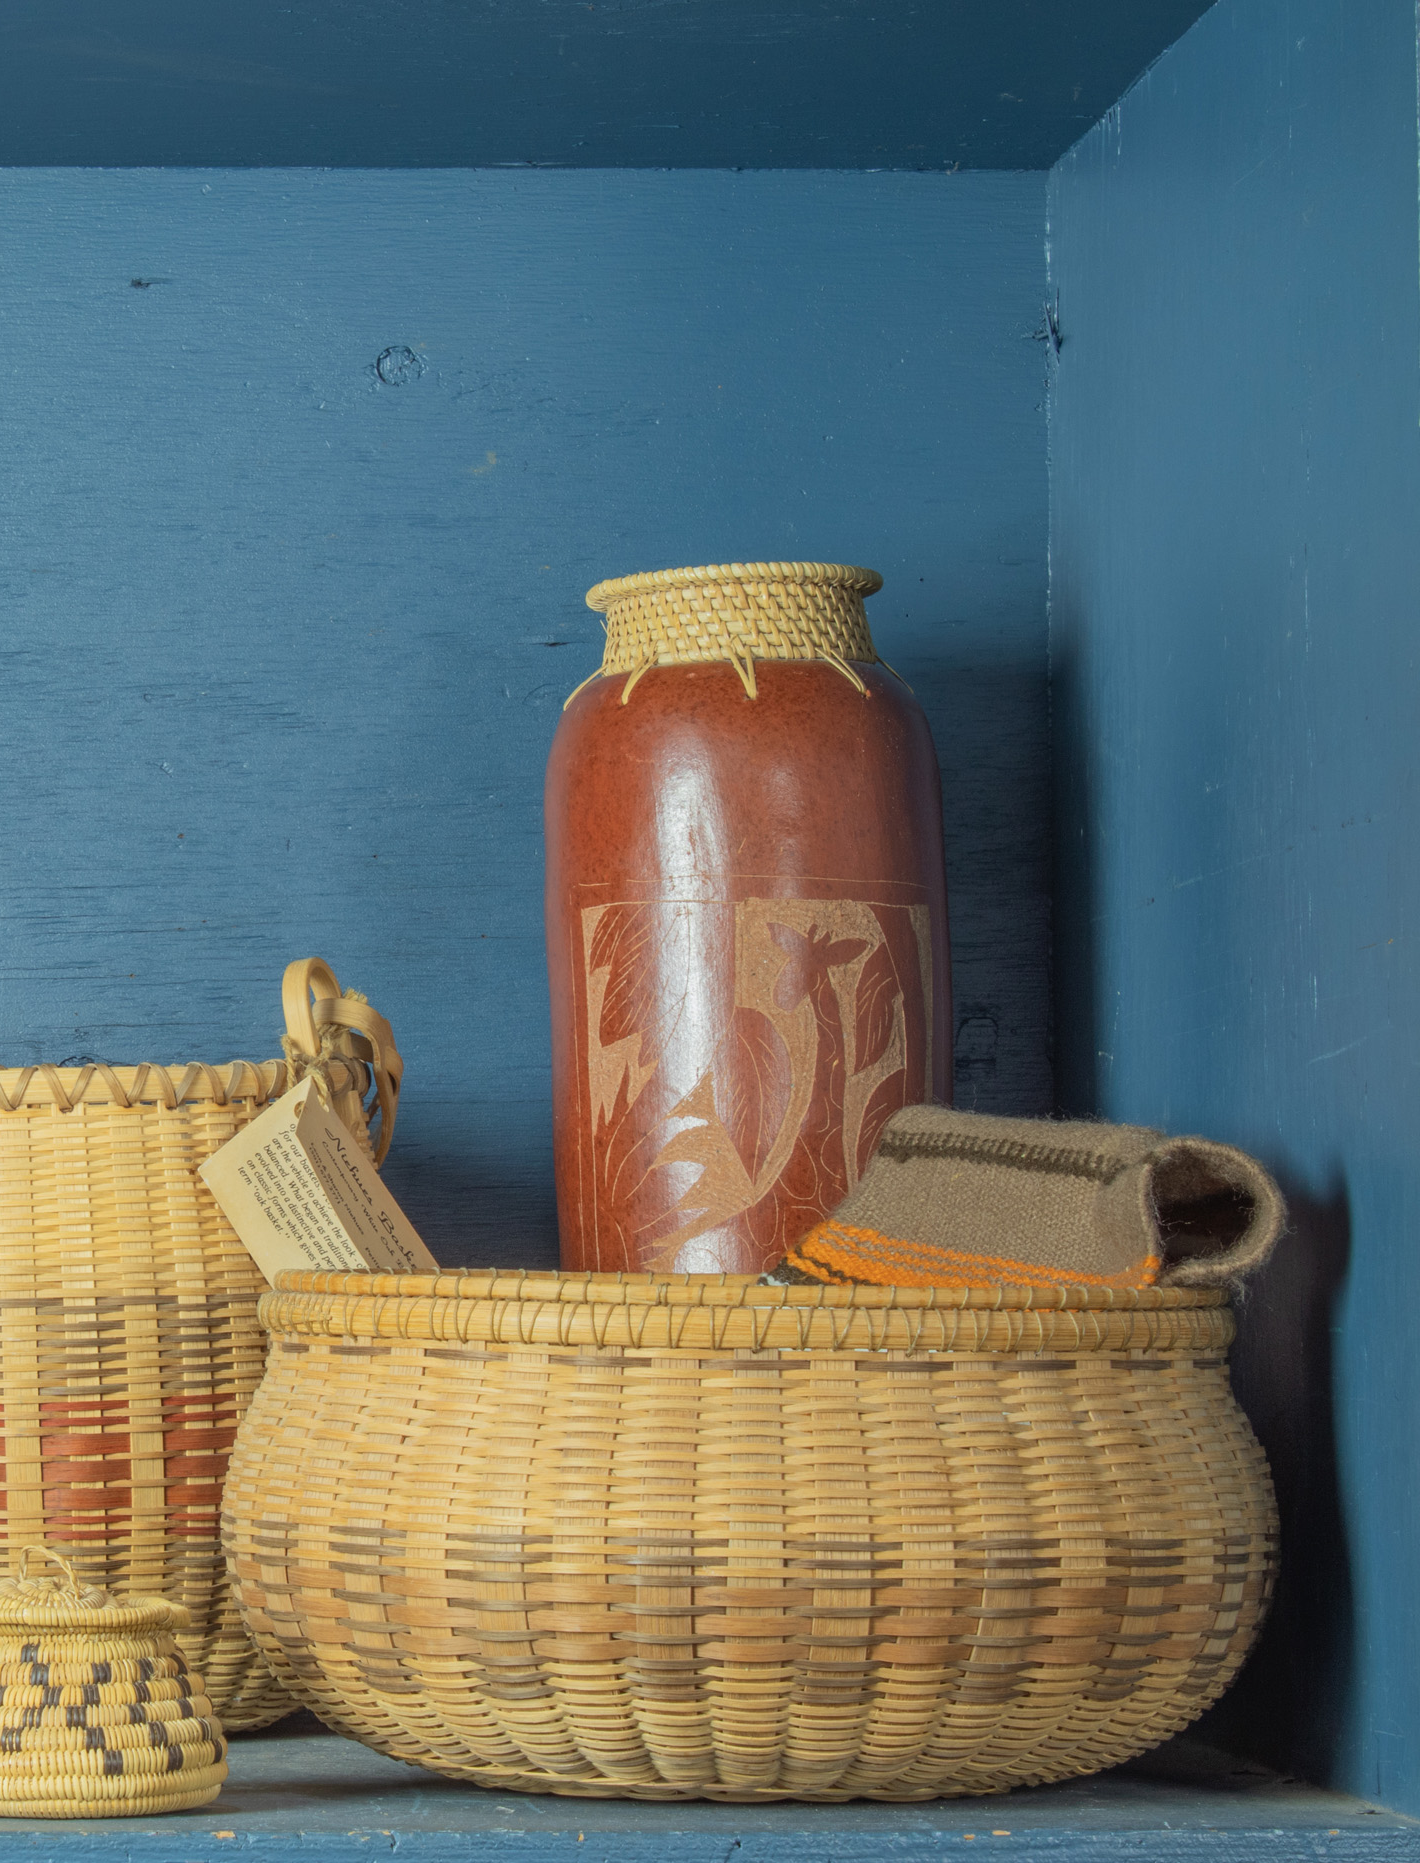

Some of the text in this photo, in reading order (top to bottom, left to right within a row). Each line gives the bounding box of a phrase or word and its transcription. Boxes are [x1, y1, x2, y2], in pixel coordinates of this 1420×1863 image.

[238, 1166, 253, 1185] term
[263, 1144, 289, 1180] balanced.
[288, 1180, 305, 1202] What
[301, 1201, 320, 1225] began
[316, 1225, 326, 1235] as
[278, 1130, 293, 1143] for
[290, 1144, 303, 1158] our
[324, 1127, 373, 1206] Niehues
[246, 1159, 256, 1170] on
[254, 1171, 273, 1195] classic
[267, 1195, 288, 1219] forms
[285, 1219, 304, 1242] which
[299, 1242, 317, 1262] gives
[254, 1152, 278, 1180] evolved
[273, 1180, 286, 1196] into
[287, 1203, 316, 1240] distinctive
[312, 1240, 328, 1255] and
[321, 1255, 337, 1269] per
[271, 1138, 283, 1150] are
[280, 1150, 292, 1163] the
[290, 1163, 309, 1189] vehicle
[306, 1189, 315, 1198] to
[312, 1199, 334, 1227] achieve
[331, 1226, 343, 1239] the
[340, 1239, 356, 1257] look
[322, 1141, 359, 1202] Contemporary
[361, 1204, 378, 1233] White
[381, 1236, 396, 1256] Oak
[327, 1173, 344, 1202] Sharon
[344, 1203, 365, 1235] Niehues
